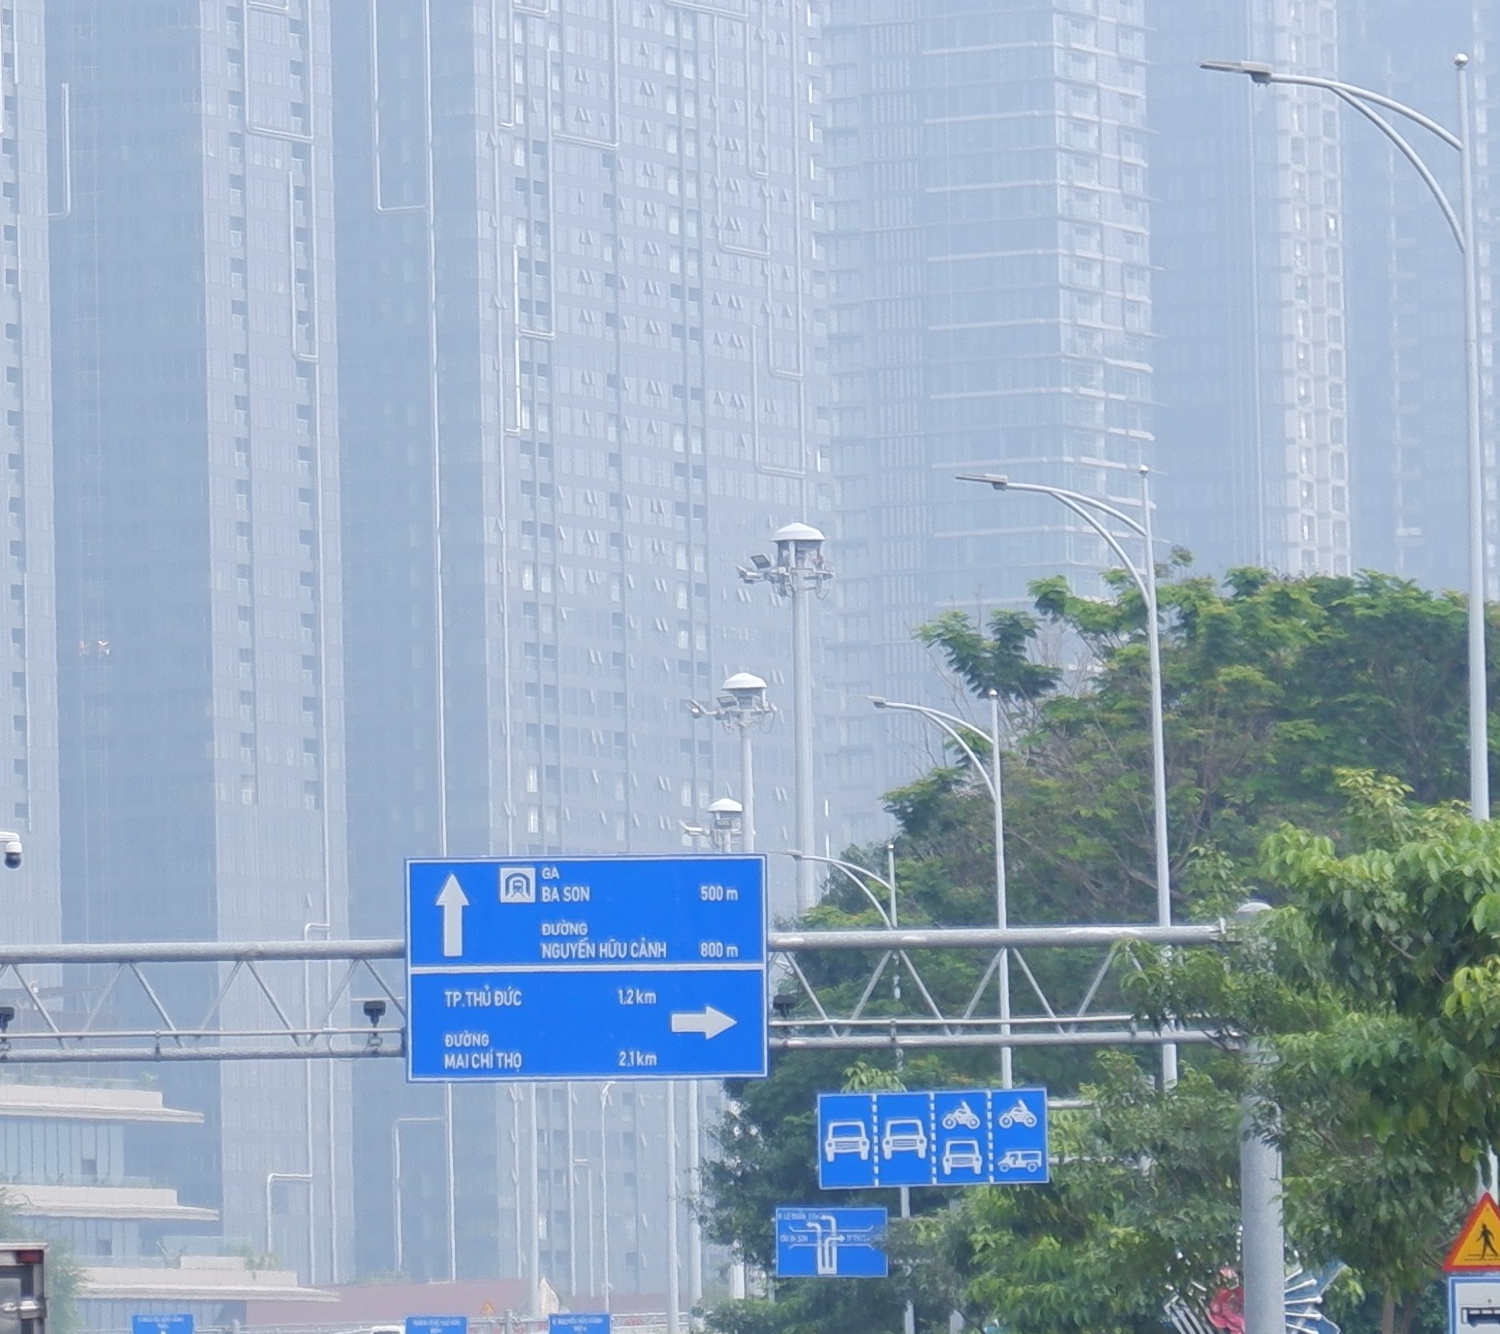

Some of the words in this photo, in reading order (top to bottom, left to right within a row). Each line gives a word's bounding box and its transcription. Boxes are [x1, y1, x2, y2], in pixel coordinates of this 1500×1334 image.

[541, 867, 560, 880] GA
[541, 886, 561, 902] BA
[563, 886, 590, 902] SON
[701, 886, 723, 901] 500
[726, 890, 739, 901] m
[541, 922, 588, 936] ĐƯỜNG
[541, 938, 596, 959] NGUYỄN
[599, 939, 627, 959] HỮU
[630, 936, 667, 959] CẢNH
[701, 942, 723, 958] 800
[726, 946, 739, 958] m
[494, 986, 522, 1006] ĐỨC
[444, 1034, 490, 1047] ĐƯỜNG
[444, 1053, 470, 1069] MAI
[471, 1050, 494, 1068] CHÍ
[496, 1052, 522, 1073] THỌ
